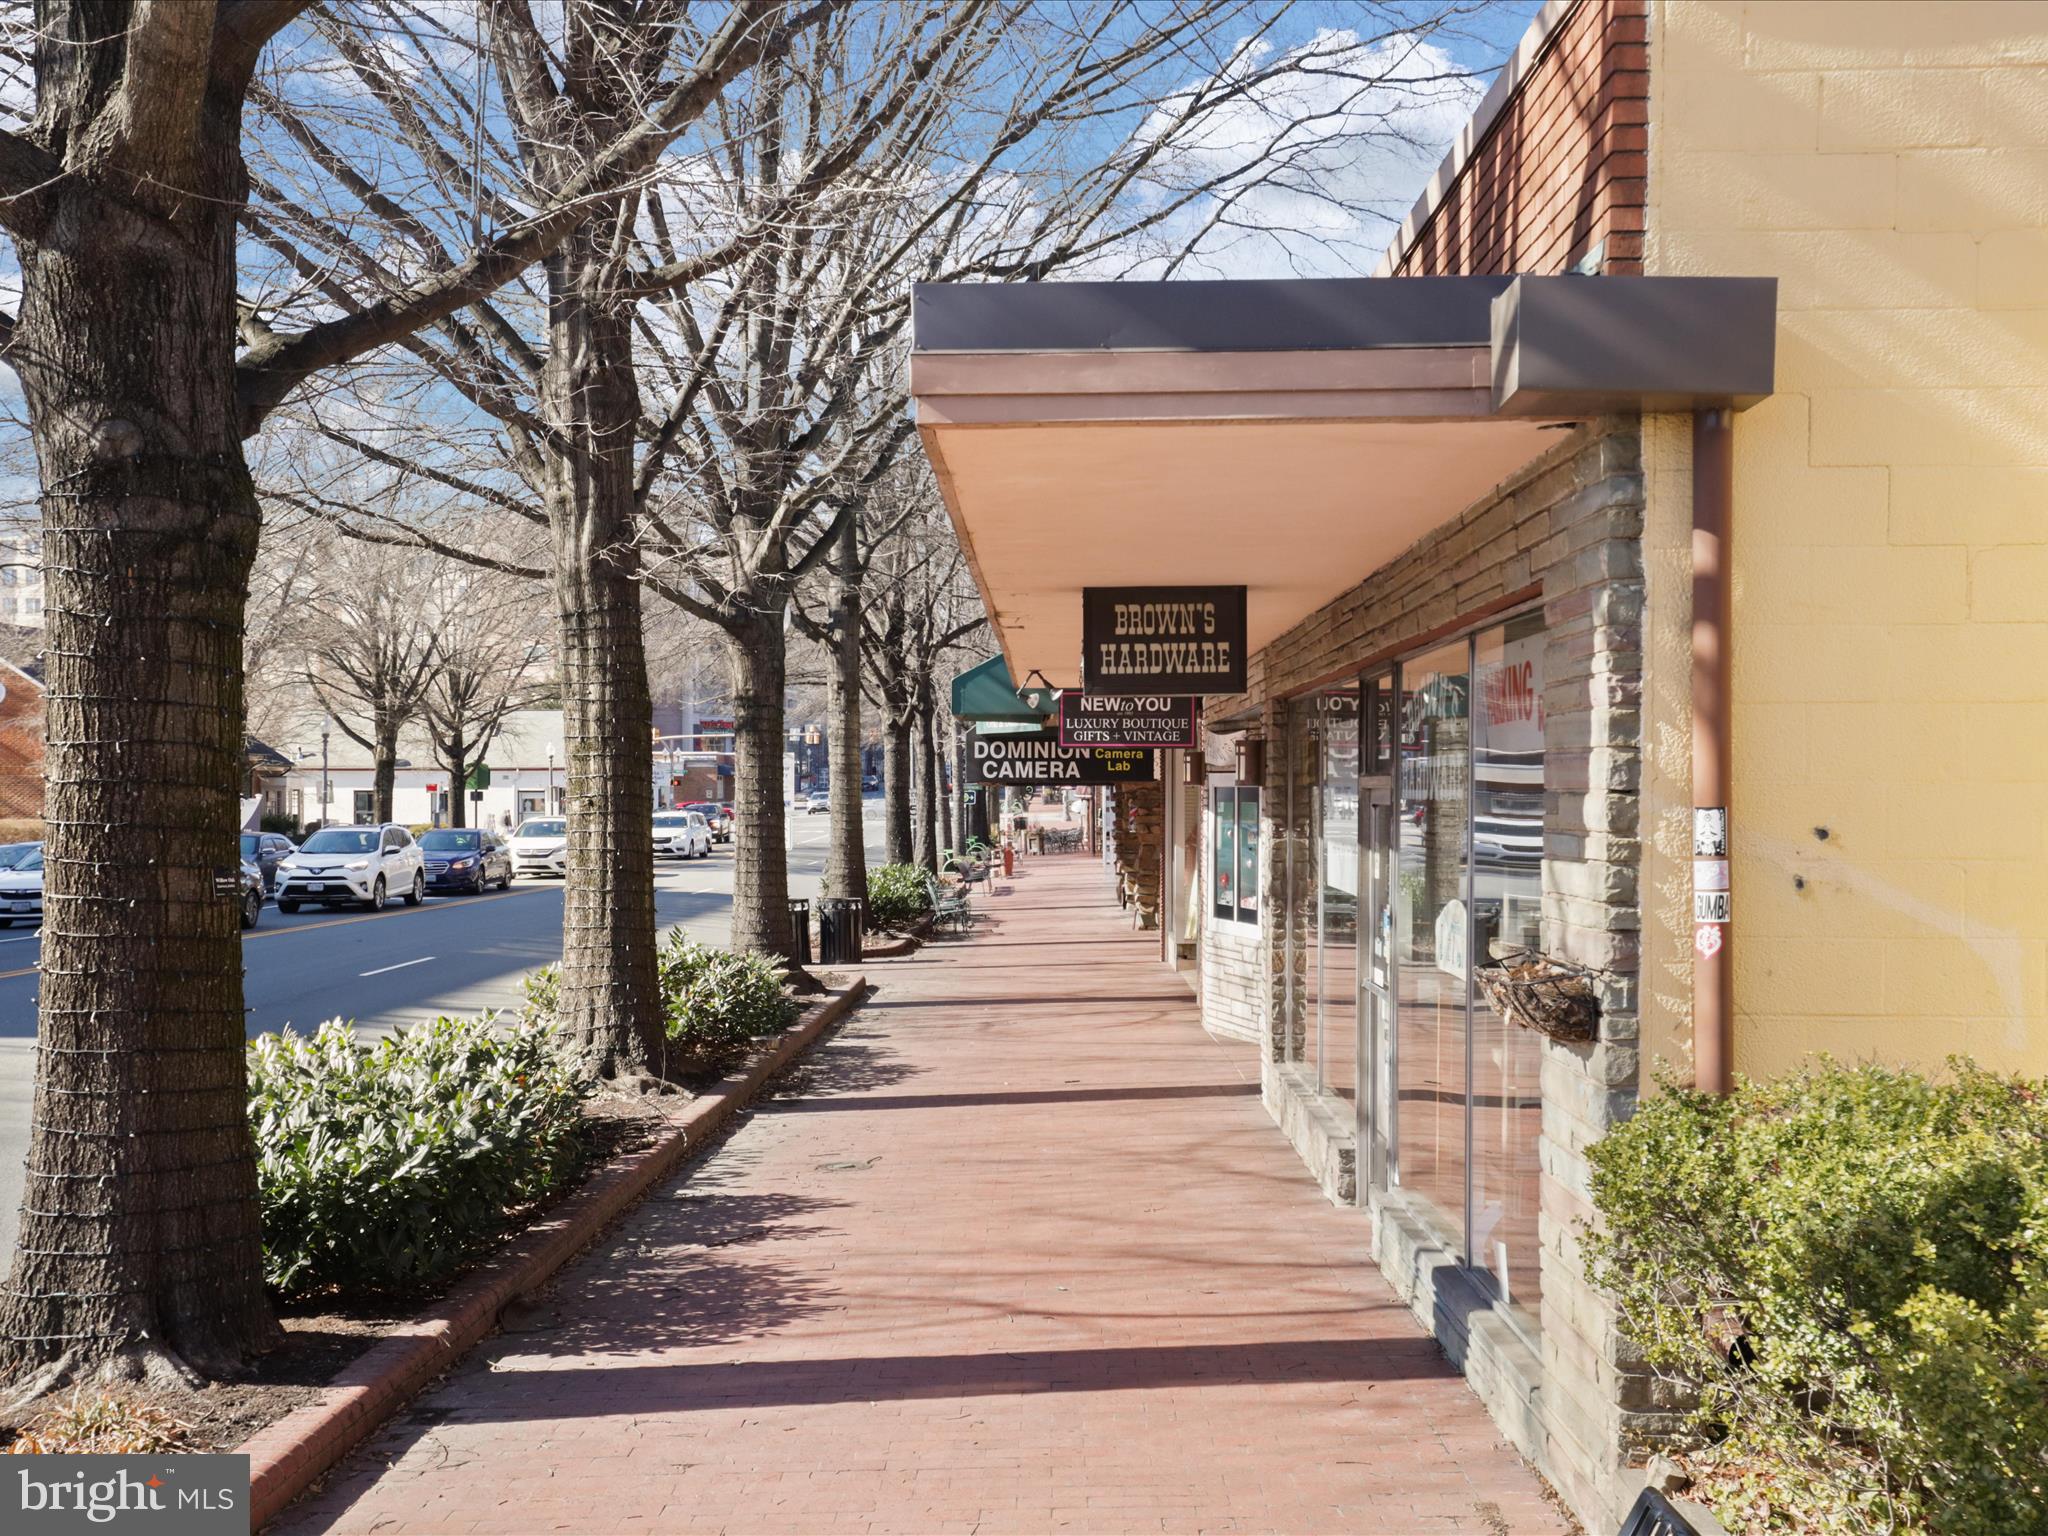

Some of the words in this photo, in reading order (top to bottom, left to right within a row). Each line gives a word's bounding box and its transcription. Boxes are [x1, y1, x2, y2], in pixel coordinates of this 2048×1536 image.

[1114, 602, 1216, 636] BROWN'S
[1100, 641, 1231, 675] HARDWARE
[1080, 697, 1120, 712] NEW
[1134, 697, 1172, 712] YOU
[1066, 718, 1119, 730] LUXURY
[1122, 718, 1189, 731] BOUTIQUE
[1073, 731, 1110, 742] GIFTS
[1123, 731, 1181, 742] VINTAGE
[974, 741, 1091, 760] DOMINION
[1095, 748, 1144, 760] Camera
[982, 761, 1081, 779] CAMERA
[1107, 761, 1131, 771] Lab
